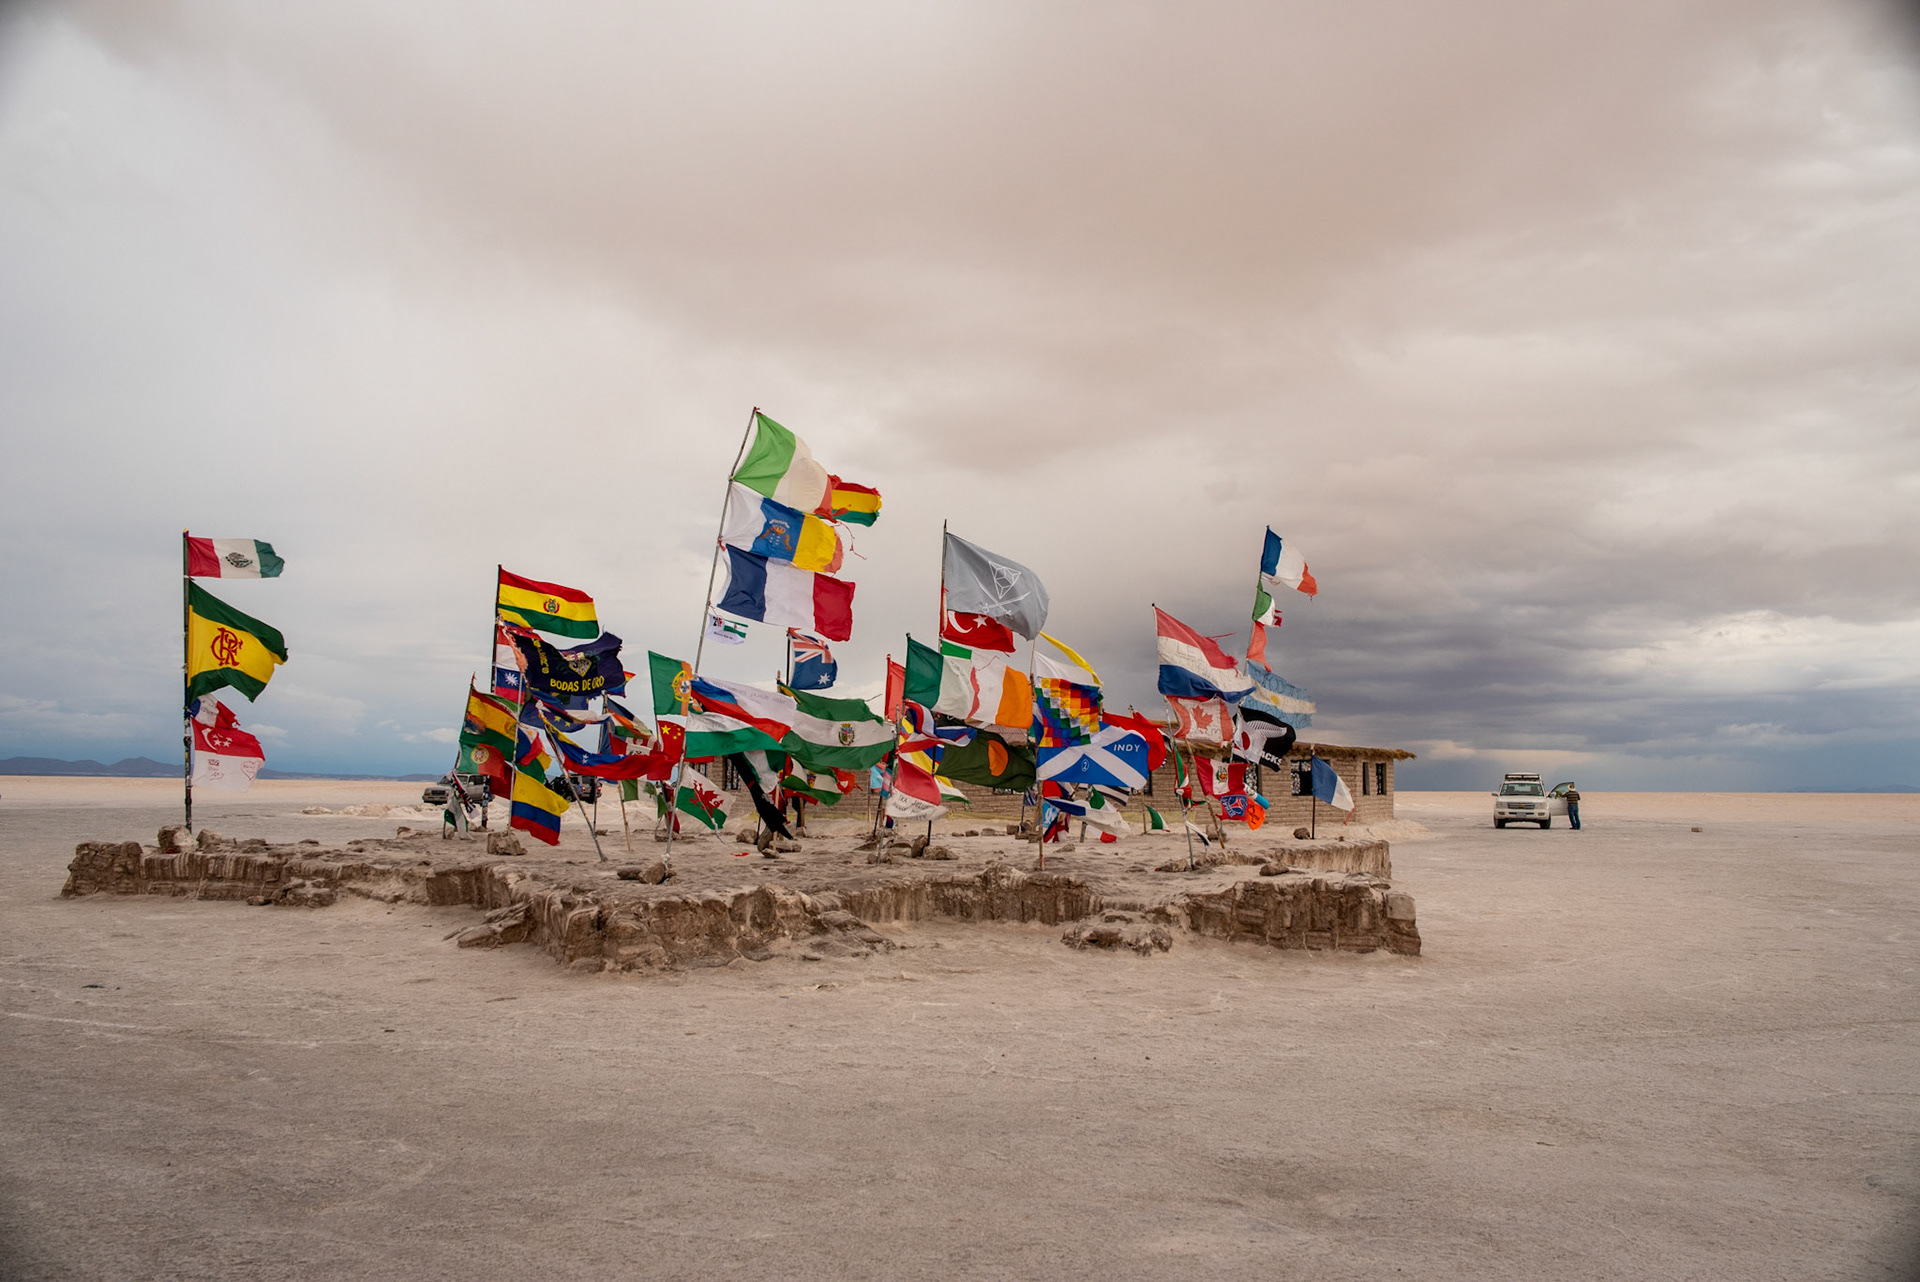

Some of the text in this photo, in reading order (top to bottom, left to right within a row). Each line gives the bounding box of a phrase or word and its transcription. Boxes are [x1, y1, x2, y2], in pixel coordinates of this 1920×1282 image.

[550, 678, 579, 692] BODAS
[582, 679, 591, 691] DE
[1113, 744, 1141, 752] INDY
